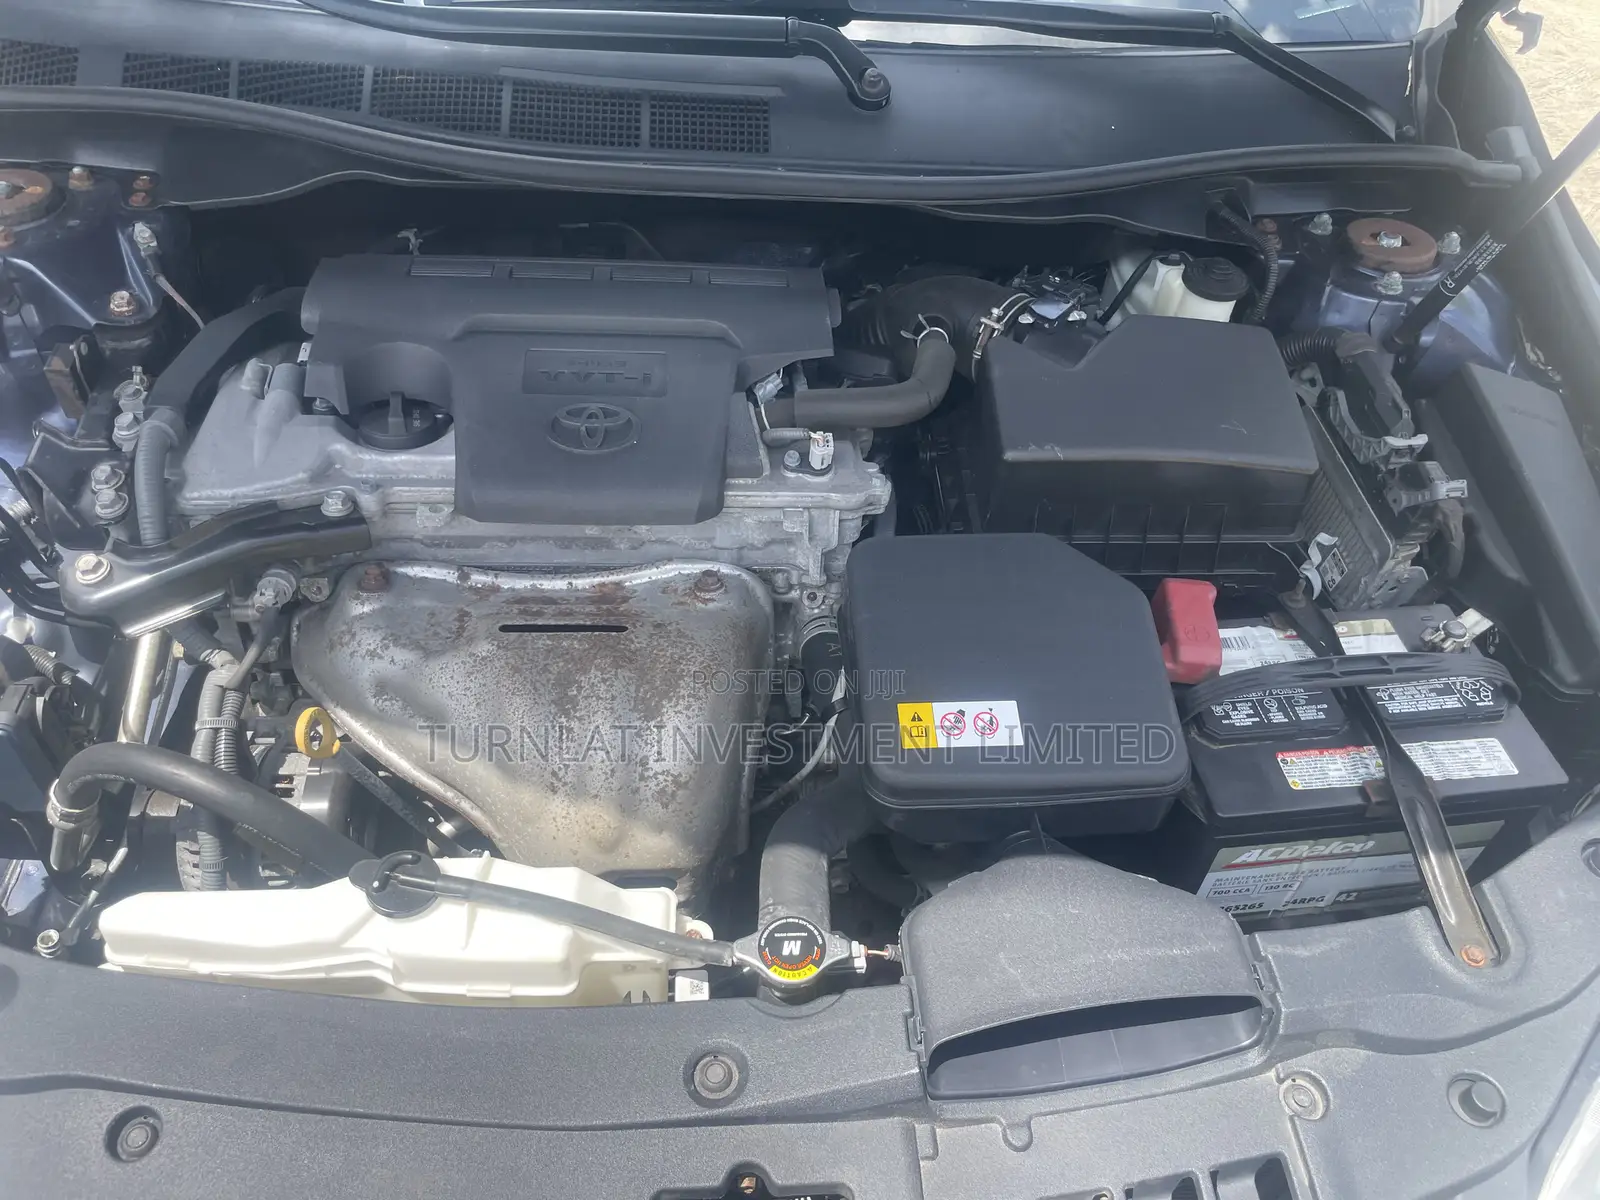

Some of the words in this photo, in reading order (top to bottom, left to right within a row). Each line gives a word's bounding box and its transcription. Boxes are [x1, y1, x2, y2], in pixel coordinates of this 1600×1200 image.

[1271, 687, 1305, 695] POISON
[1231, 840, 1376, 864] ACDelco
[1214, 871, 1281, 883] MAINTENANCE
[772, 967, 808, 979] CAUTION
